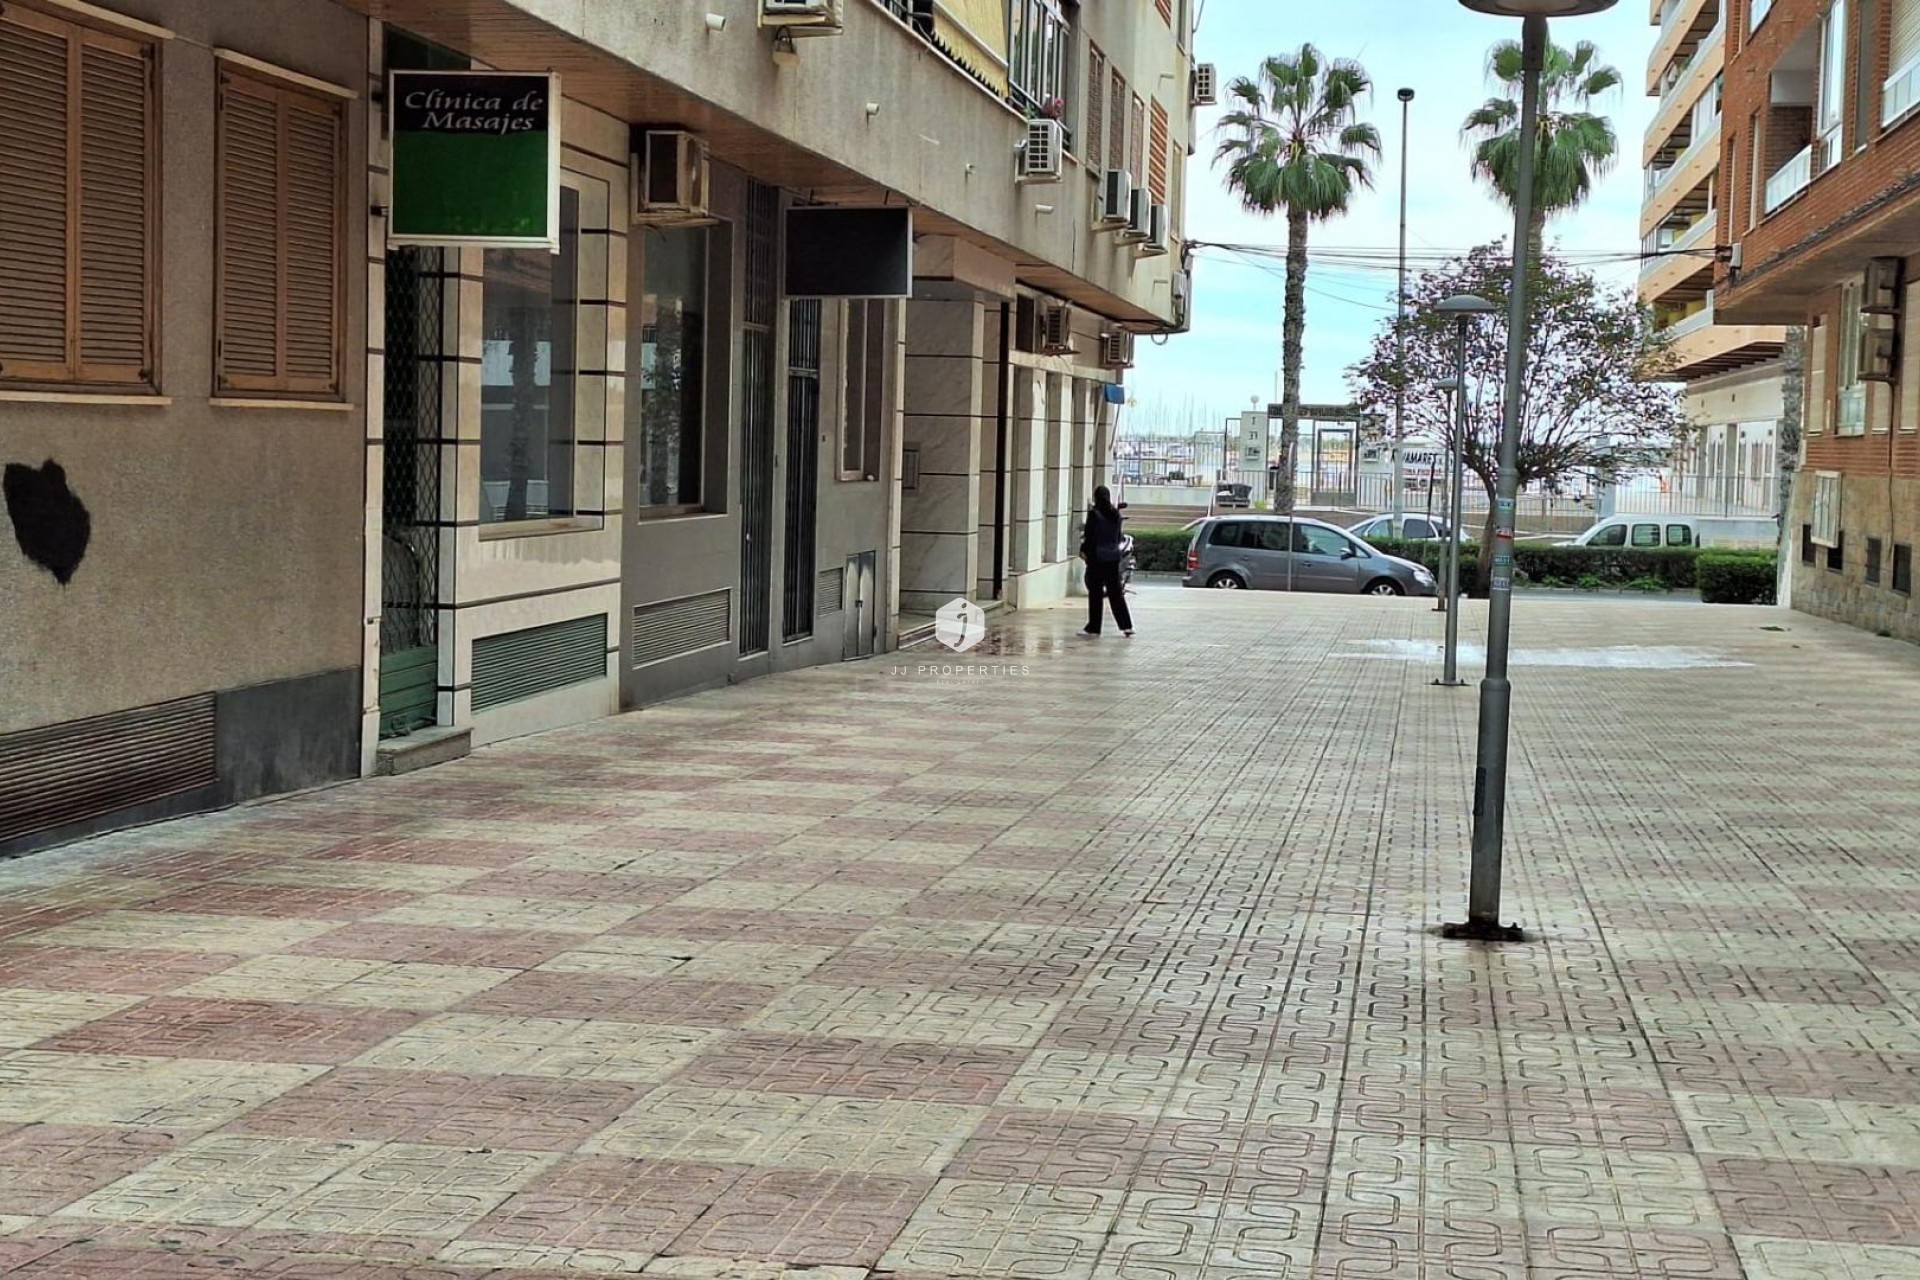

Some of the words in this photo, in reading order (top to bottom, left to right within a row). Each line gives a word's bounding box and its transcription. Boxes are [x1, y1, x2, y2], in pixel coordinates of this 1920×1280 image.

[405, 88, 502, 110] Clínica
[512, 90, 543, 110] de
[421, 112, 535, 135] Masajes
